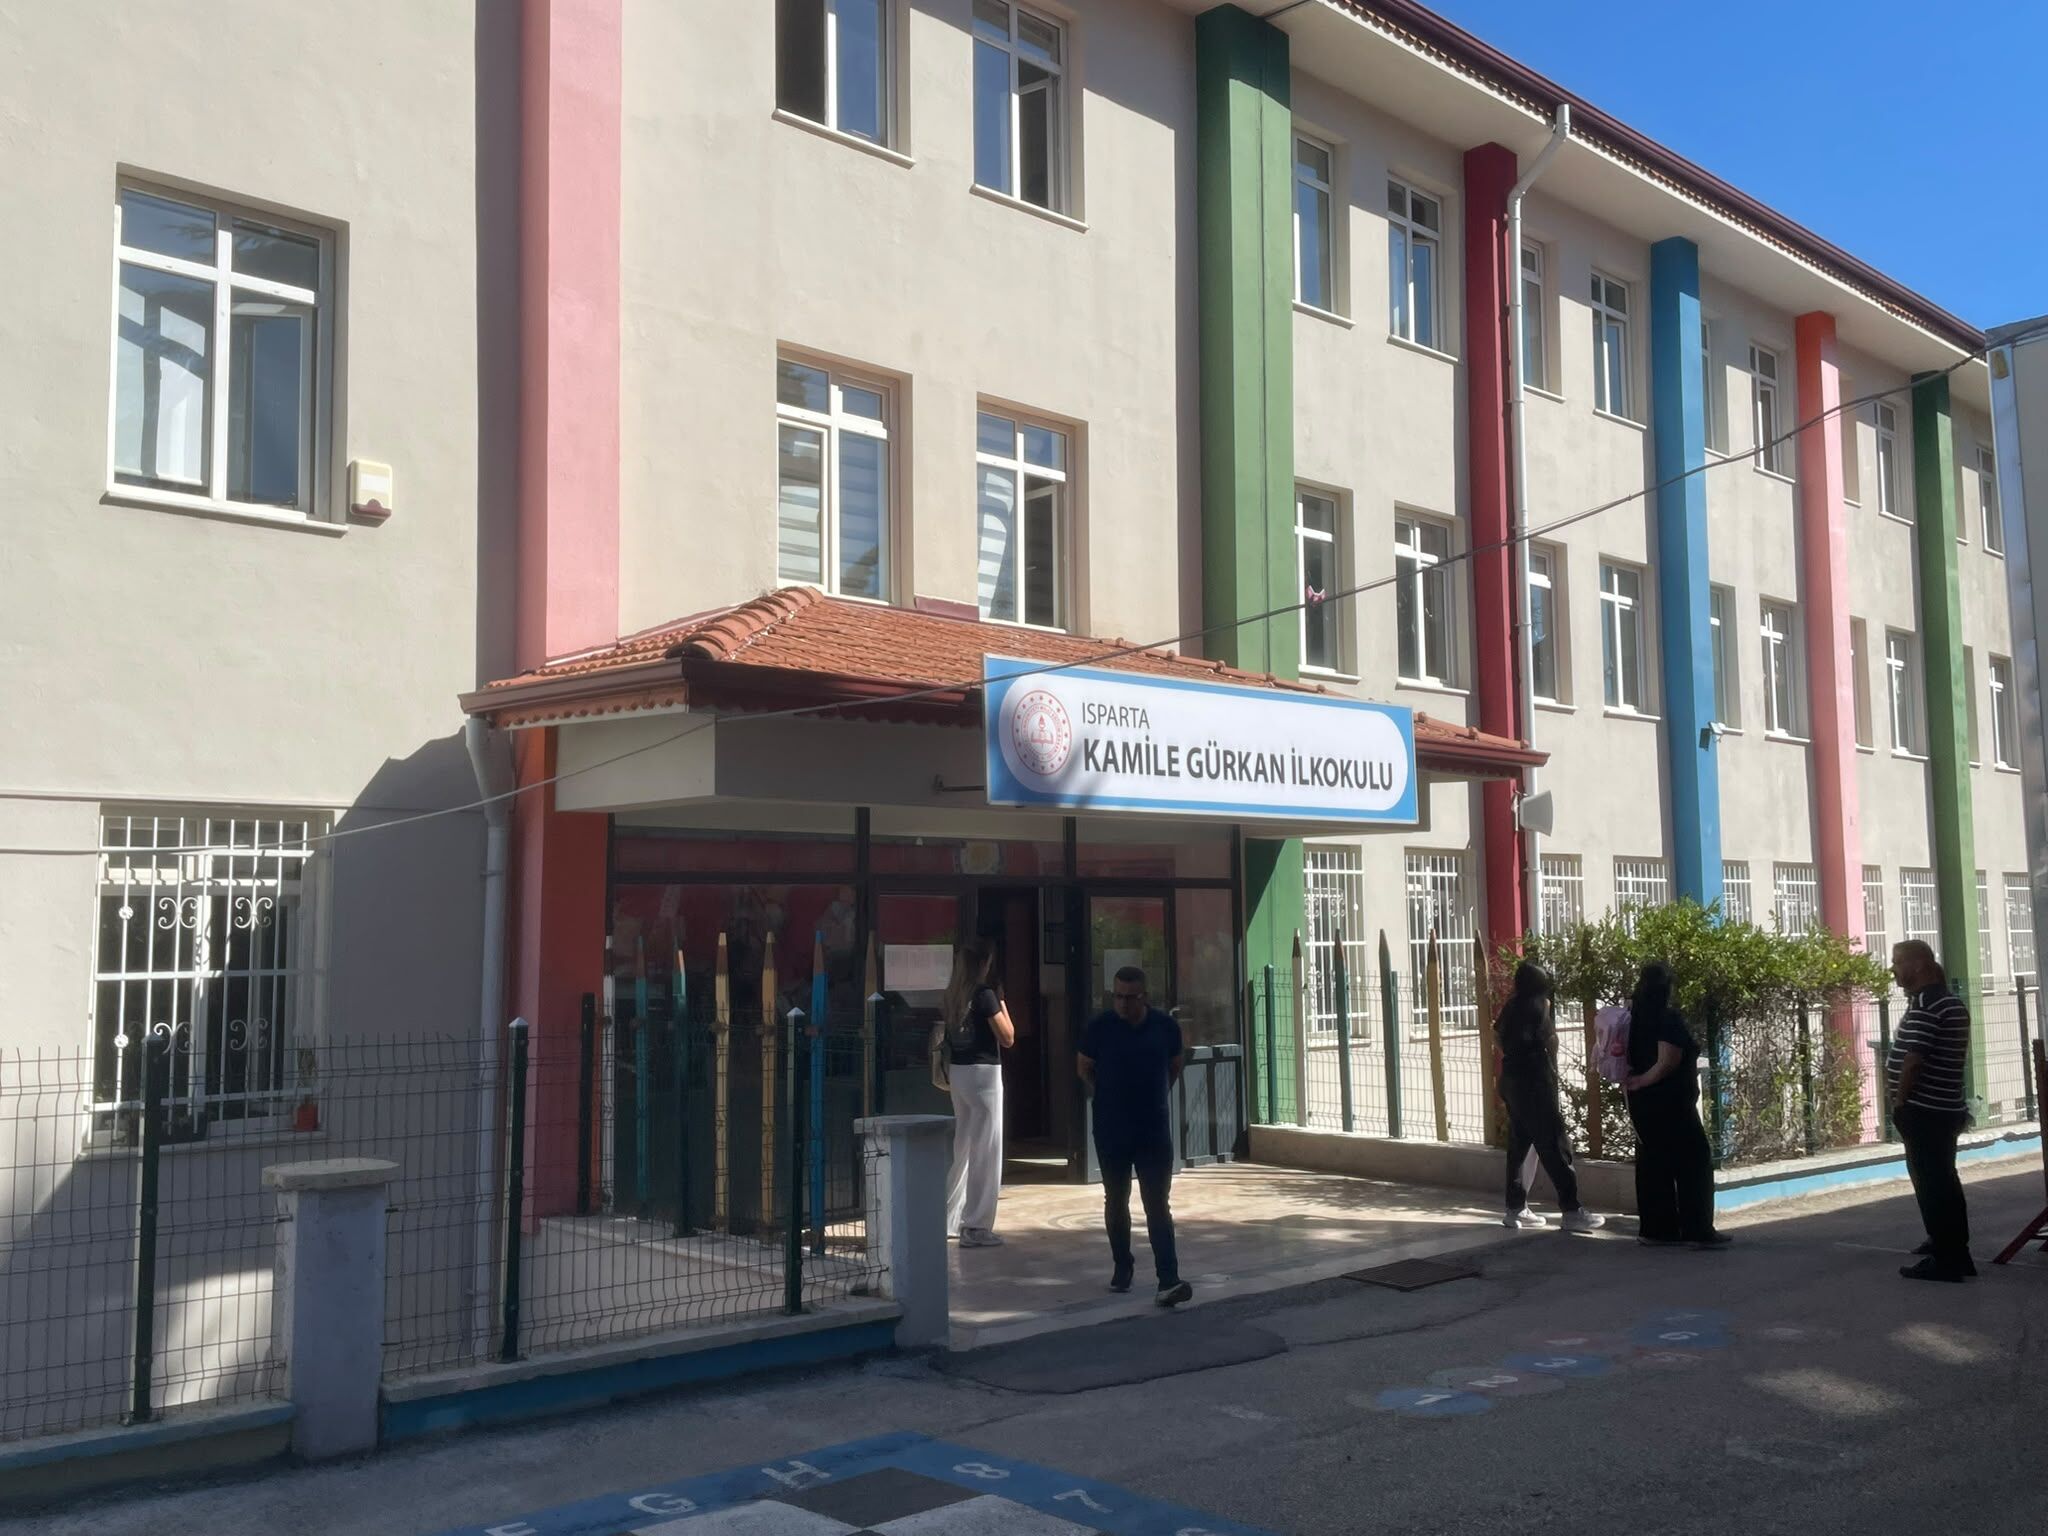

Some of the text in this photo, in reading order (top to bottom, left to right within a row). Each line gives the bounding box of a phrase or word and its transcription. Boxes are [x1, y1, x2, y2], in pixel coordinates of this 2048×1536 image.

[1082, 702, 1150, 730] ISPARTA
[1083, 735, 1393, 791] KAMİLE GÜRKAN İLKOKULU
[628, 1492, 699, 1515] G
[761, 1460, 833, 1490] H
[952, 1461, 1114, 1514] 8 7
